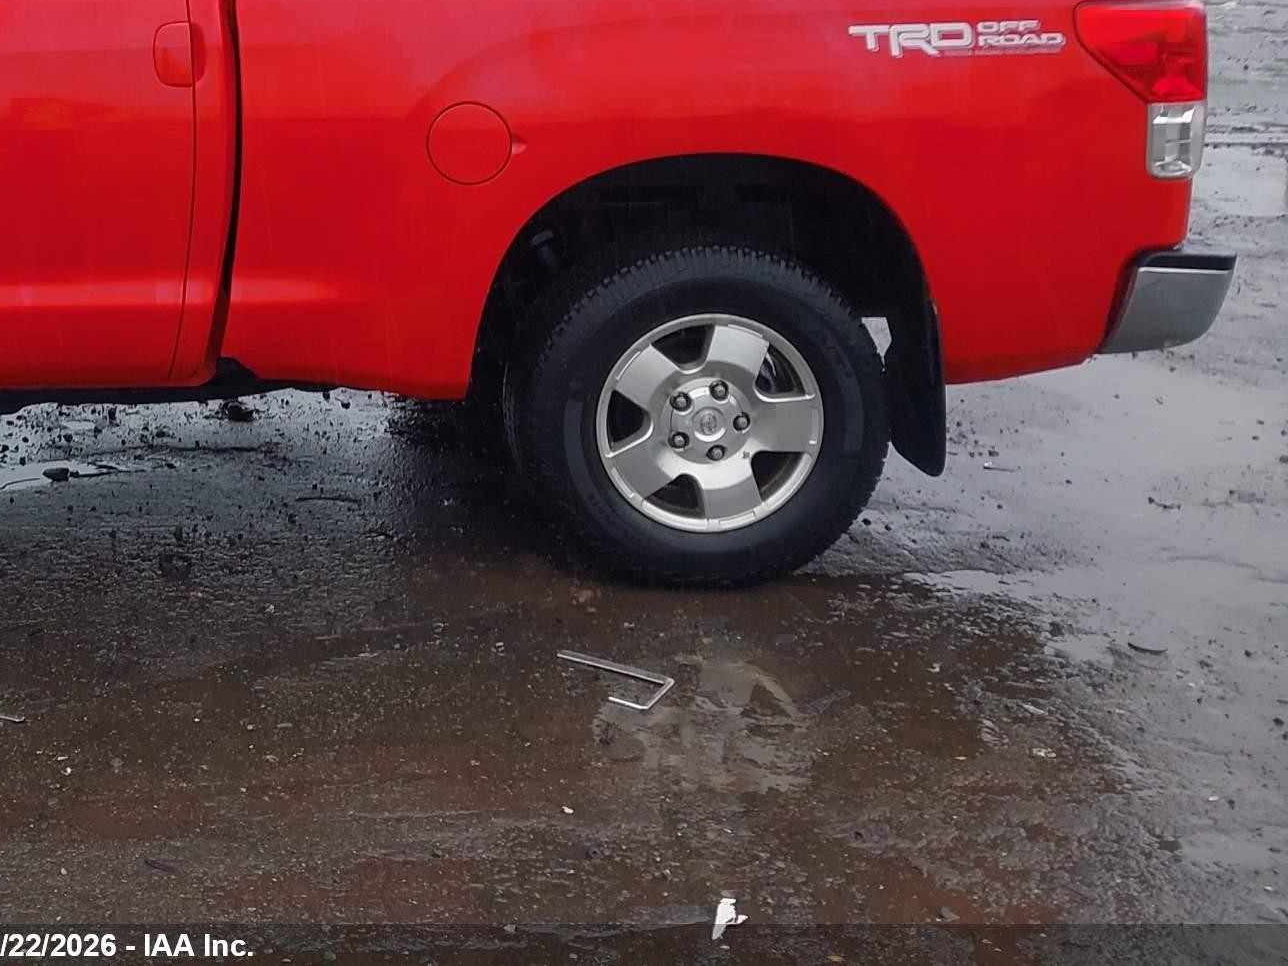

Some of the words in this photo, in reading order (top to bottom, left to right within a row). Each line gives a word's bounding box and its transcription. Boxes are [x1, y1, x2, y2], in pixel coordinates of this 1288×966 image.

[977, 19, 1040, 33] OFF
[848, 22, 975, 58] TRD
[978, 32, 1066, 47] ROAD
